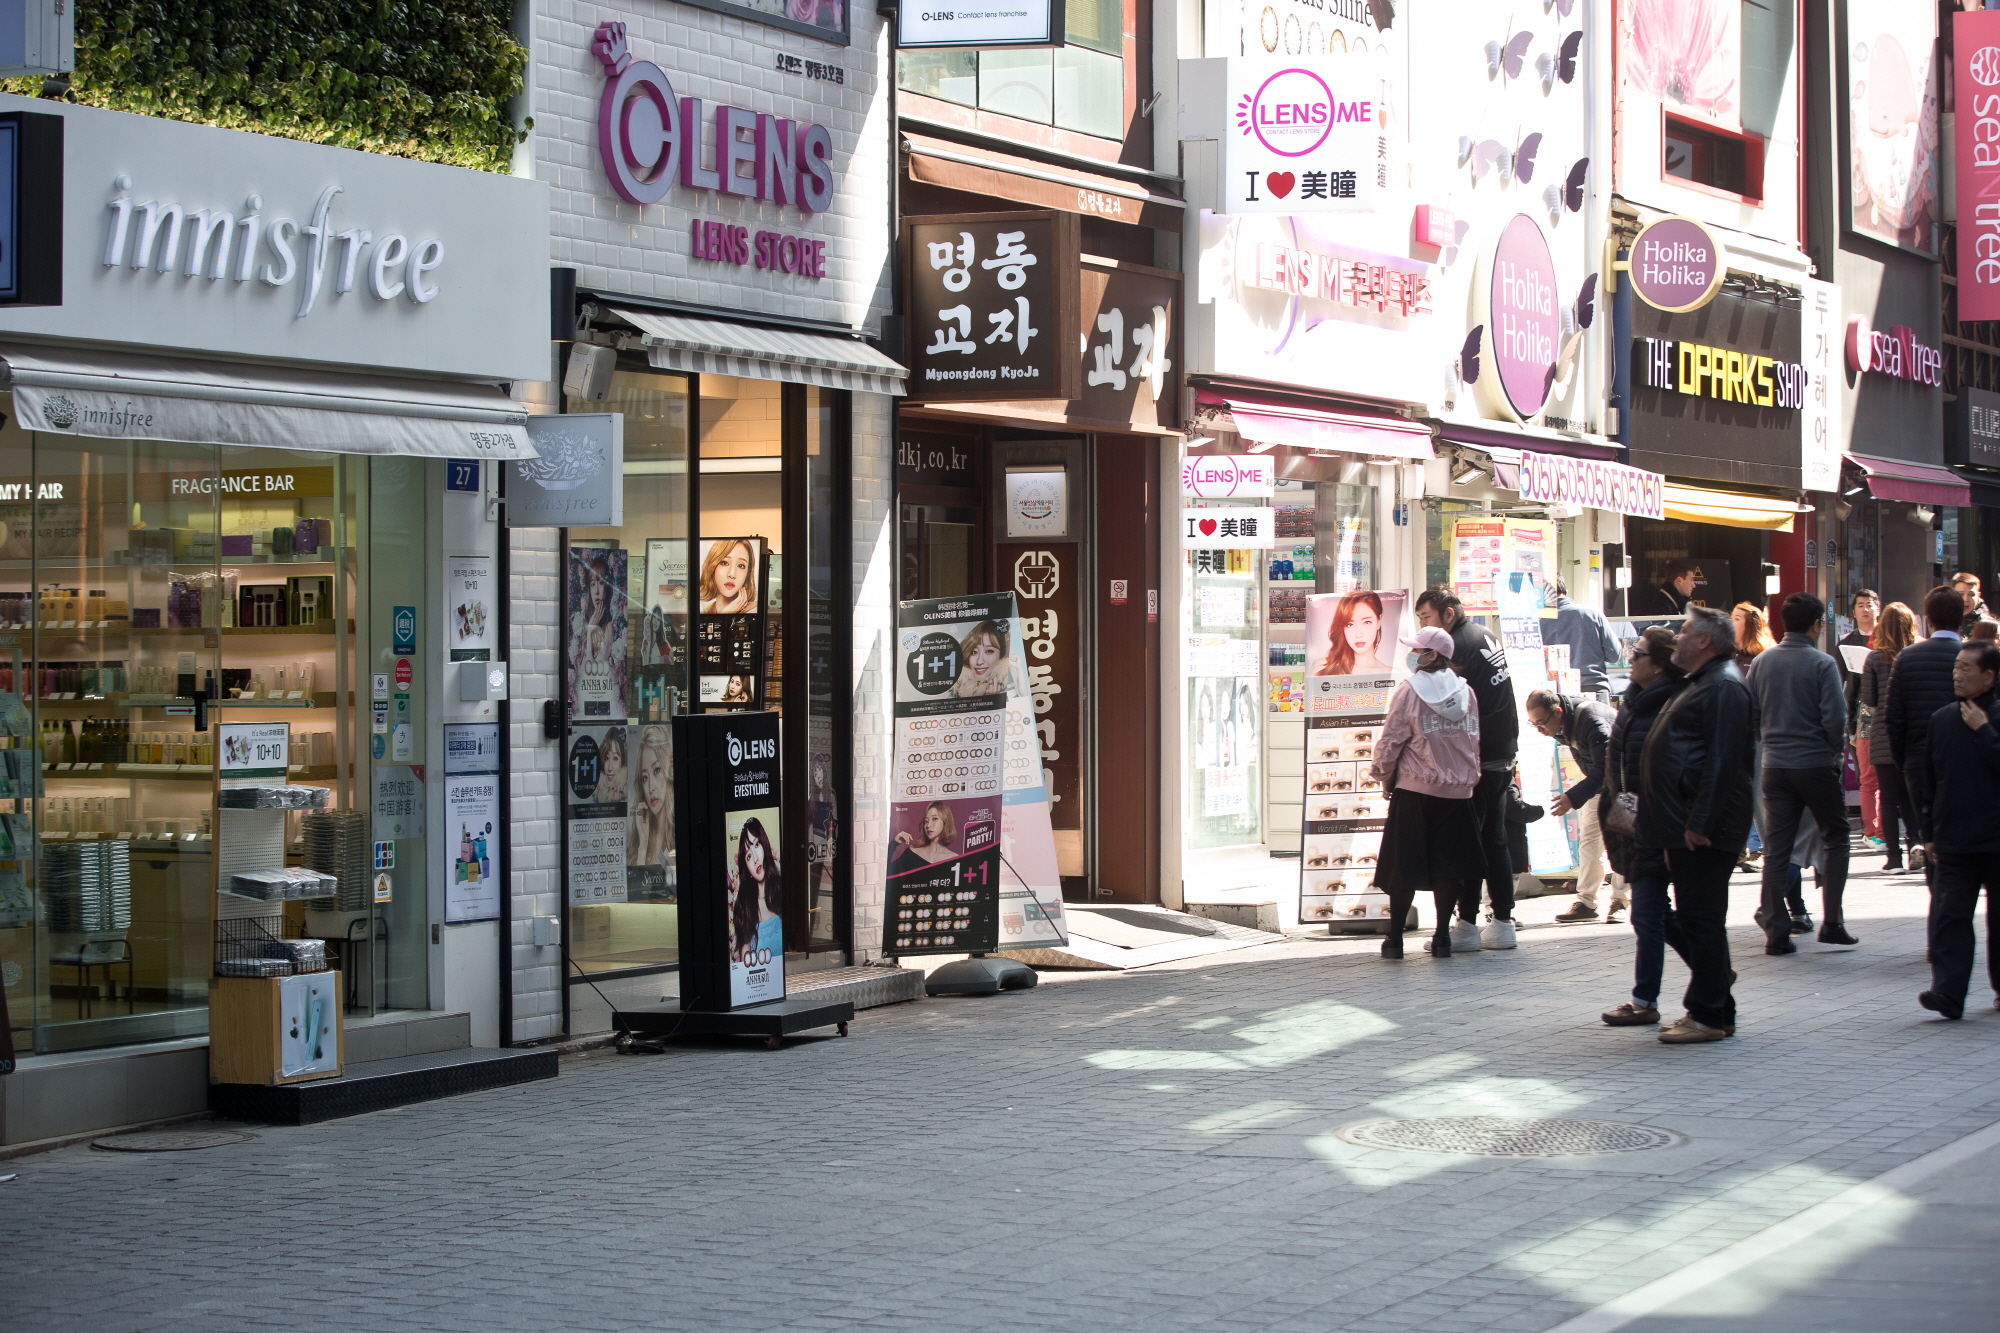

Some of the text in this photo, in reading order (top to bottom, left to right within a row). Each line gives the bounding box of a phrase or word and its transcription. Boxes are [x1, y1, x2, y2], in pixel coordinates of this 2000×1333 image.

[922, 11, 954, 21] O-LENS
[957, 11, 984, 19] Contact
[999, 10, 1028, 18] franchise
[776, 53, 844, 85] 오렌즈 명동3호점
[1259, 101, 1371, 126] LENS ME
[1245, 170, 1357, 201] I 美瞳
[1087, 191, 1122, 217] 명동교자
[103, 174, 445, 318] innisfree
[692, 218, 826, 279] LENS STORE
[1643, 241, 1707, 263] Holika
[926, 230, 1038, 292] 명동
[1256, 242, 1313, 298] LENS
[1317, 254, 1355, 305] ME
[1643, 264, 1706, 286] Holika
[1501, 260, 1552, 317] Holika
[925, 295, 1039, 356] 교자
[1502, 312, 1553, 367] Holika
[926, 366, 1040, 382] Myeongdong KyoJa
[1645, 337, 1673, 390] THE
[83, 400, 153, 433] innisfree
[469, 431, 517, 450] 명동2가점
[265, 475, 295, 492] BAR
[455, 466, 472, 486] 27
[1196, 469, 1262, 483] LENS ME
[524, 493, 598, 514] innisfree
[1220, 518, 1258, 537] 美瞳
[912, 650, 957, 681] 1+1
[633, 674, 667, 711] 1+1
[1320, 719, 1339, 728] Asian
[1340, 718, 1350, 727] Fit
[256, 743, 281, 761] 10+10
[571, 754, 599, 784] 1+1
[379, 780, 415, 797] 热烈欢迎
[734, 782, 769, 798] EYESTYLING
[966, 830, 993, 849] PARTY!
[969, 825, 989, 836] monthly
[1317, 825, 1338, 833] World
[1339, 824, 1348, 832] Fit
[374, 850, 394, 860] JCB
[950, 860, 989, 887] 1+1
